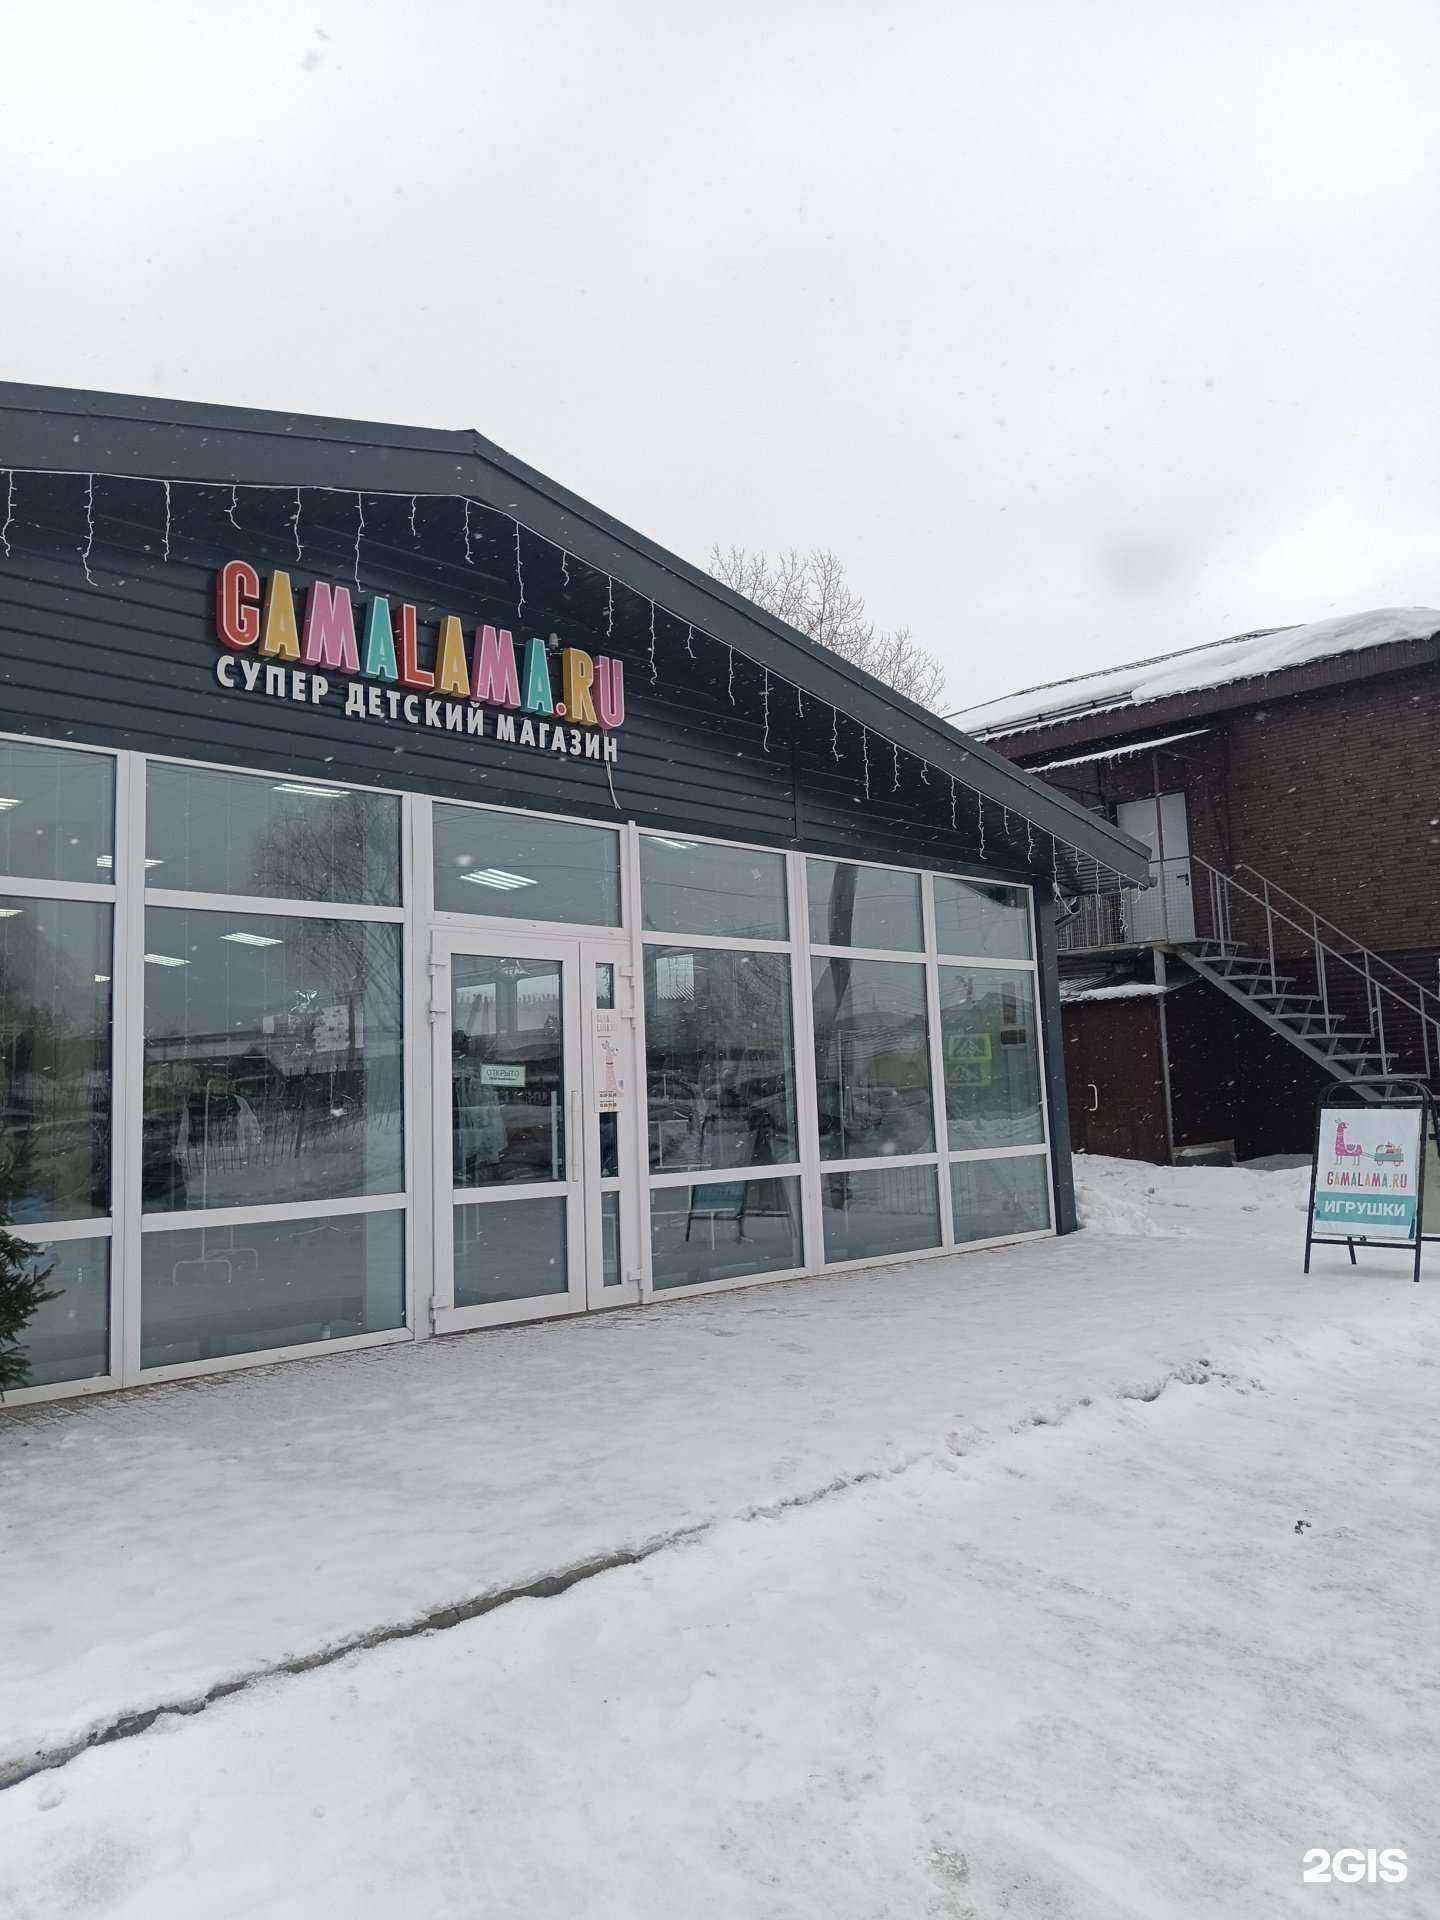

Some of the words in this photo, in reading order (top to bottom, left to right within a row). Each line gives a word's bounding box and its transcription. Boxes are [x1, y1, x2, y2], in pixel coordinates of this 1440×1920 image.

[216, 559, 625, 730] GAMALAMA.RU
[216, 655, 329, 705] СУПЕР
[345, 682, 485, 736] ДЕТСКИЙ
[496, 713, 618, 763] МАГАЗИН
[1324, 1200, 1406, 1217] ИГРУШКИ
[1327, 1171, 1408, 1189] GAMALAMA.RU
